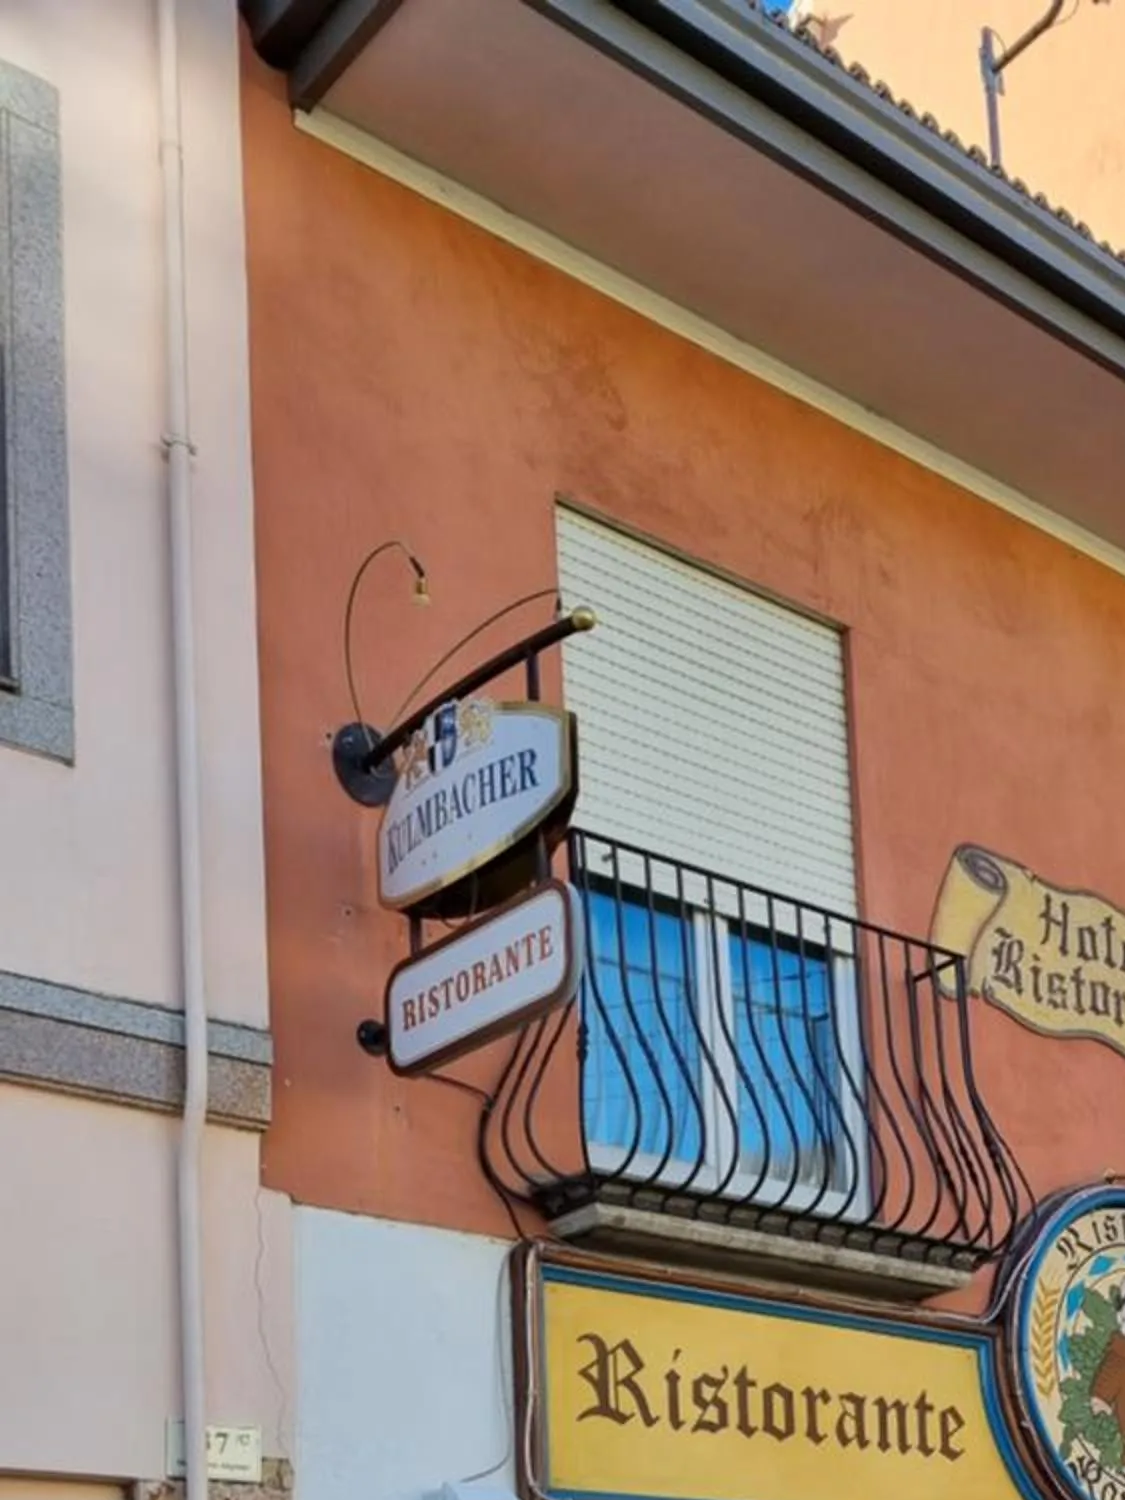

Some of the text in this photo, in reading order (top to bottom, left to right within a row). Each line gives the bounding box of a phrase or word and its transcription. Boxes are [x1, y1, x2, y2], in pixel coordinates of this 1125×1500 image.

[386, 746, 541, 876] KULMBACHER
[402, 925, 553, 1033] RISTORANTE
[576, 1332, 966, 1462] Ristorante
